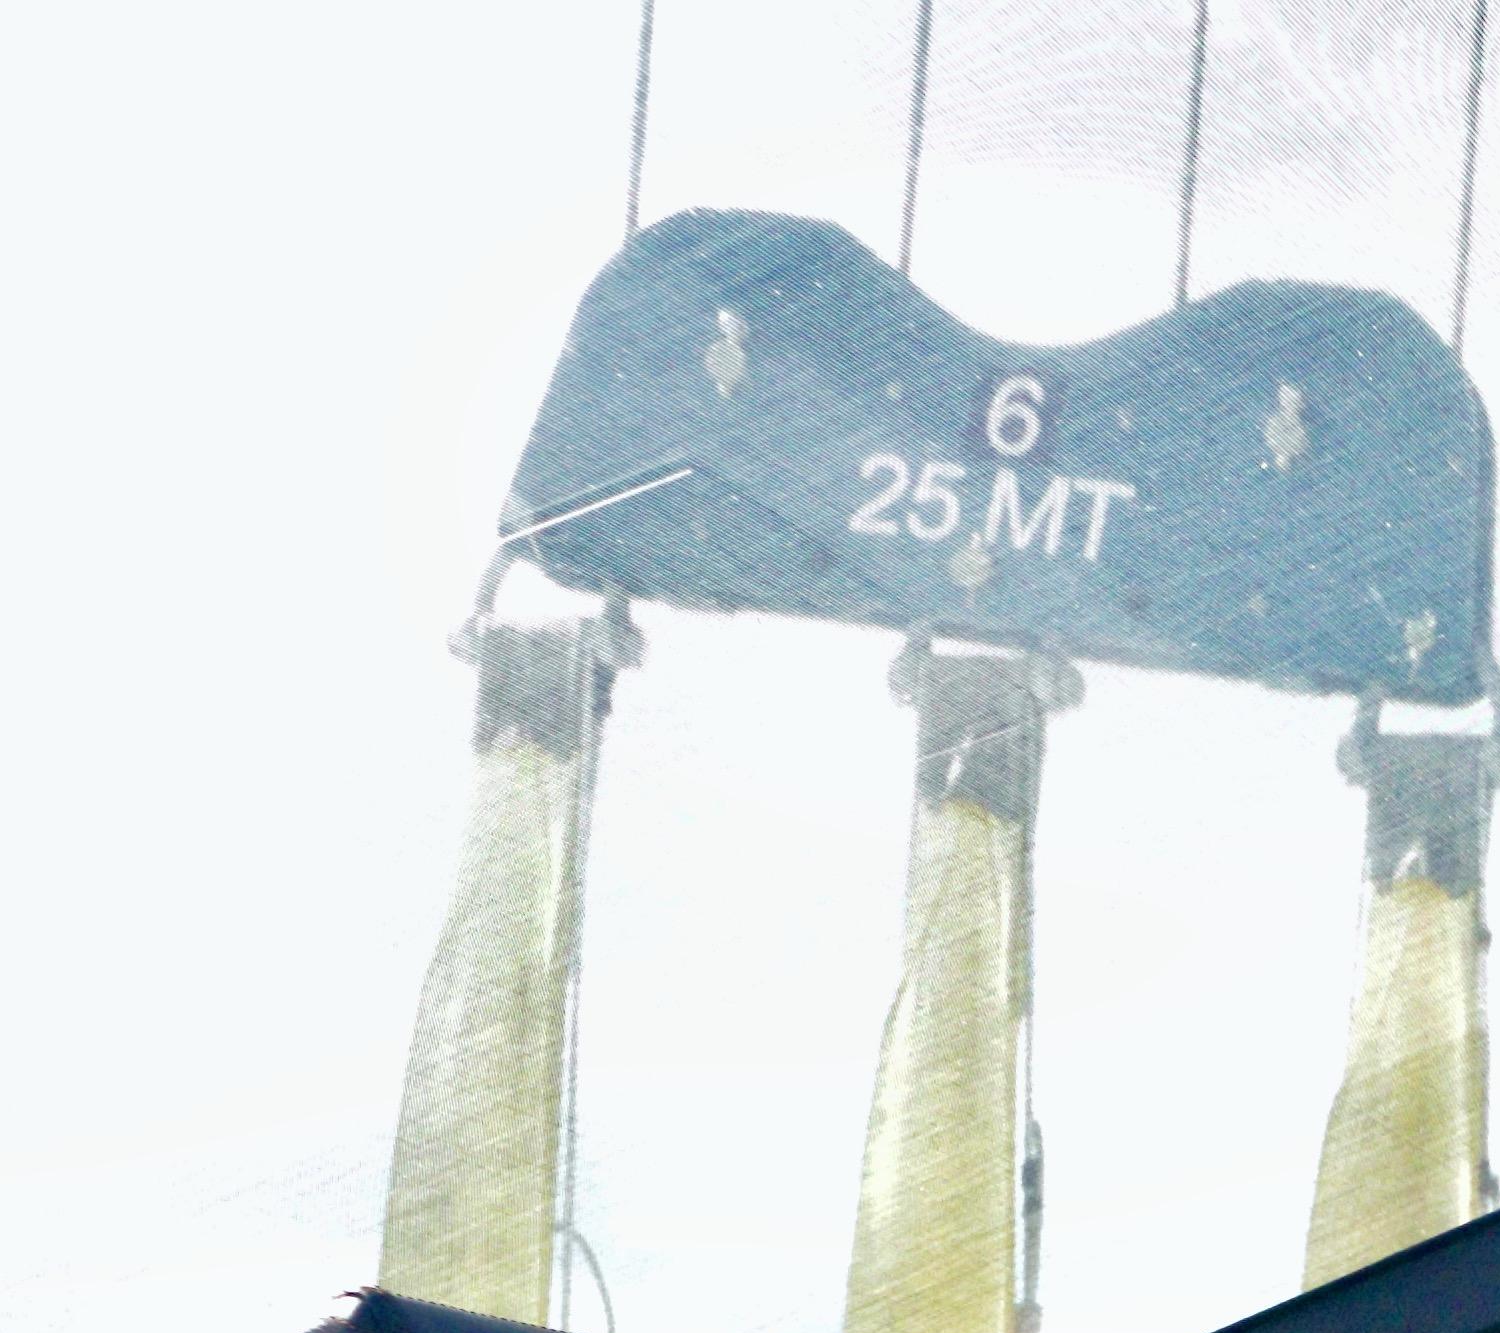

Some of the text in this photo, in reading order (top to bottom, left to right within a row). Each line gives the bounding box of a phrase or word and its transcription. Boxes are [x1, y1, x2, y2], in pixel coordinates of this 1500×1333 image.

[986, 373, 1046, 458] 6
[849, 452, 1137, 562] 25 MT
